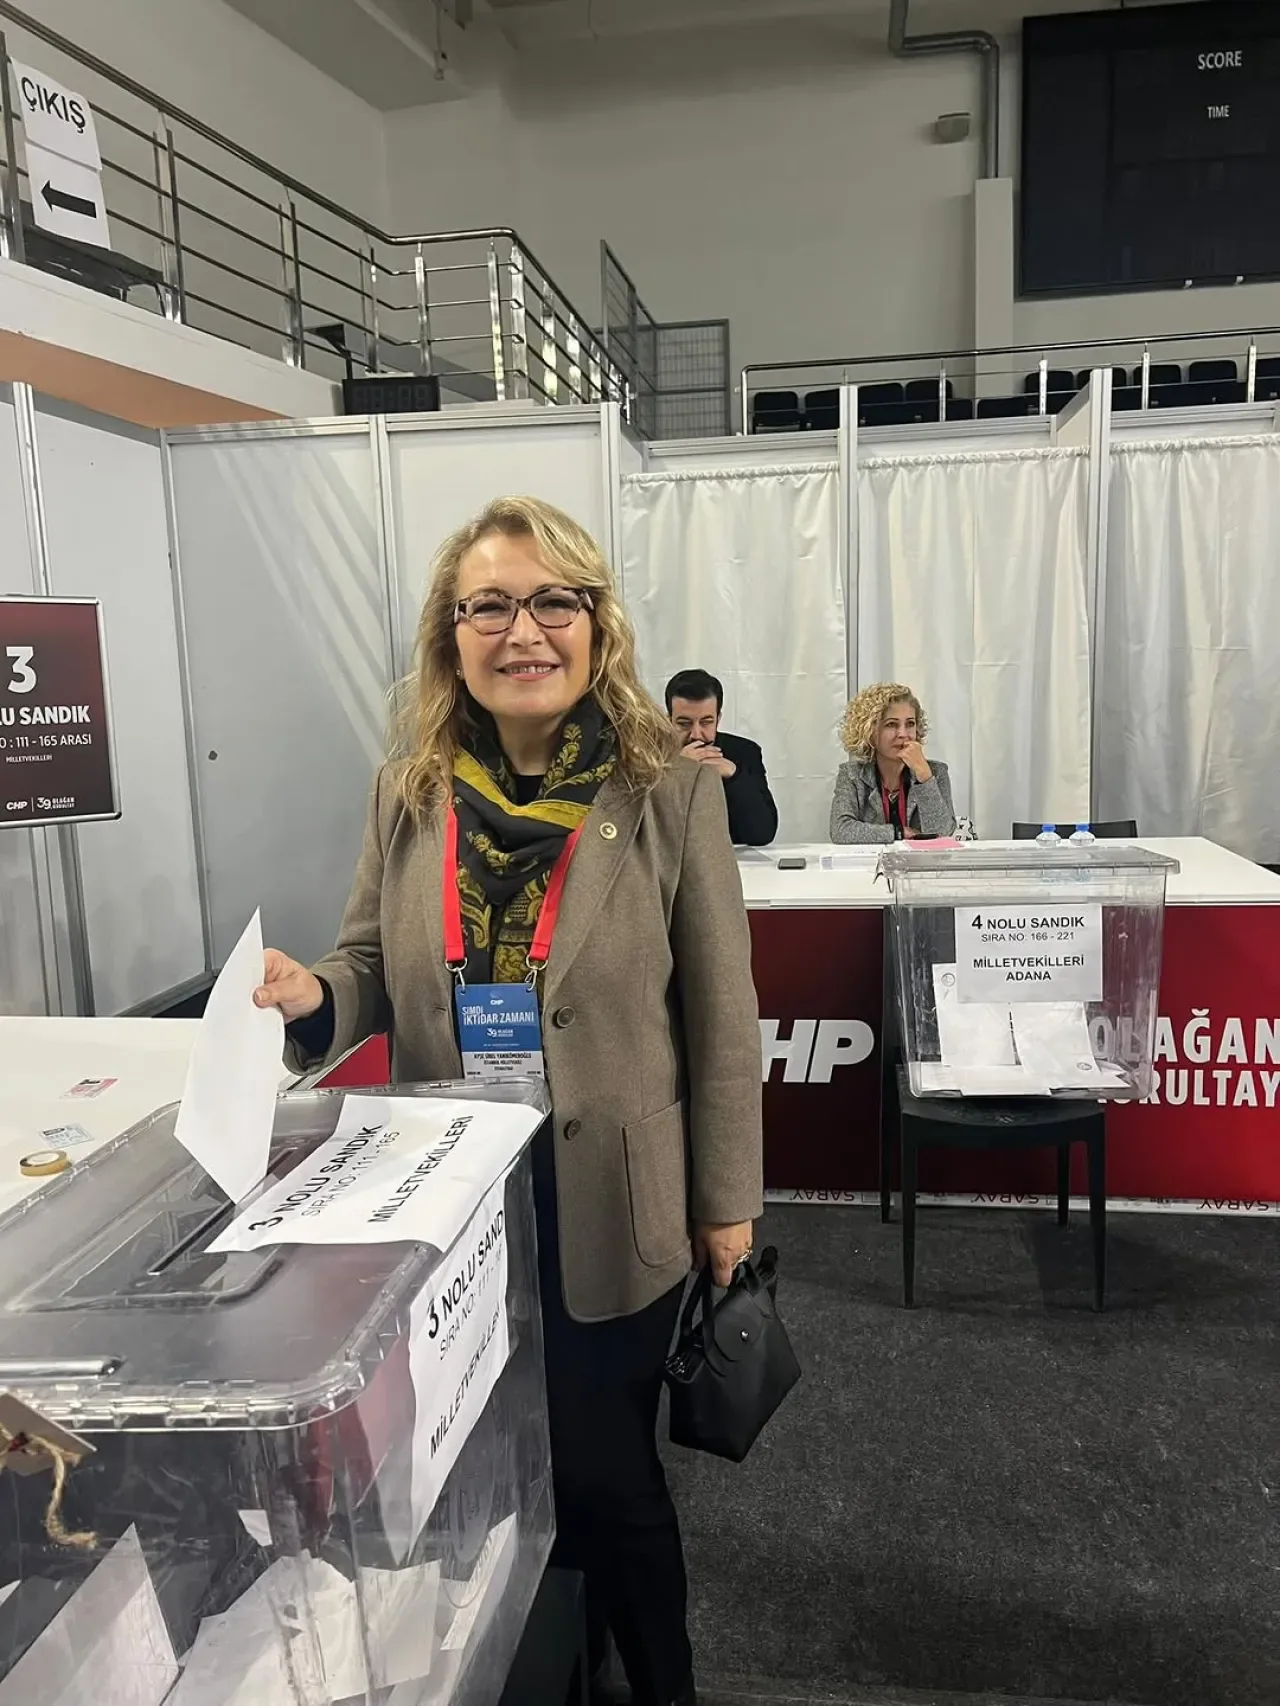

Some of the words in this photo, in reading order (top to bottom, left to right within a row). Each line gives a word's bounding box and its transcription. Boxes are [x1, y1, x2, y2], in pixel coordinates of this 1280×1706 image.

[1197, 50, 1243, 70] SCORE
[21, 76, 86, 134] ÇIKIŞ
[1207, 104, 1230, 119] TIME
[6, 646, 37, 694] 3
[0, 706, 15, 726] U
[19, 705, 91, 725] SANDIK
[16, 736, 29, 748] 111
[39, 735, 58, 747] 165
[6, 801, 28, 810] CHP
[971, 914, 983, 930] 4
[987, 918, 1026, 930] NOLU
[1030, 916, 1085, 929] SANDIK
[981, 933, 1006, 943] SIRA
[1031, 932, 1049, 941] 166
[1057, 931, 1075, 941] 221
[973, 954, 1085, 969] MİLLETVEKİLLERİ
[1006, 970, 1052, 982] ADANA
[499, 1011, 535, 1024] ZAMANI
[248, 1216, 283, 1231] 3
[273, 1176, 331, 1213] NOLU
[320, 1124, 383, 1173] SANDIK
[301, 1192, 341, 1217] SIRA
[376, 1131, 400, 1149] 165
[367, 1115, 474, 1222] MİLLETVEKİLLERİ
[427, 1298, 440, 1340] 3
[442, 1253, 475, 1321] NOLU
[440, 1317, 460, 1361] SIRA
